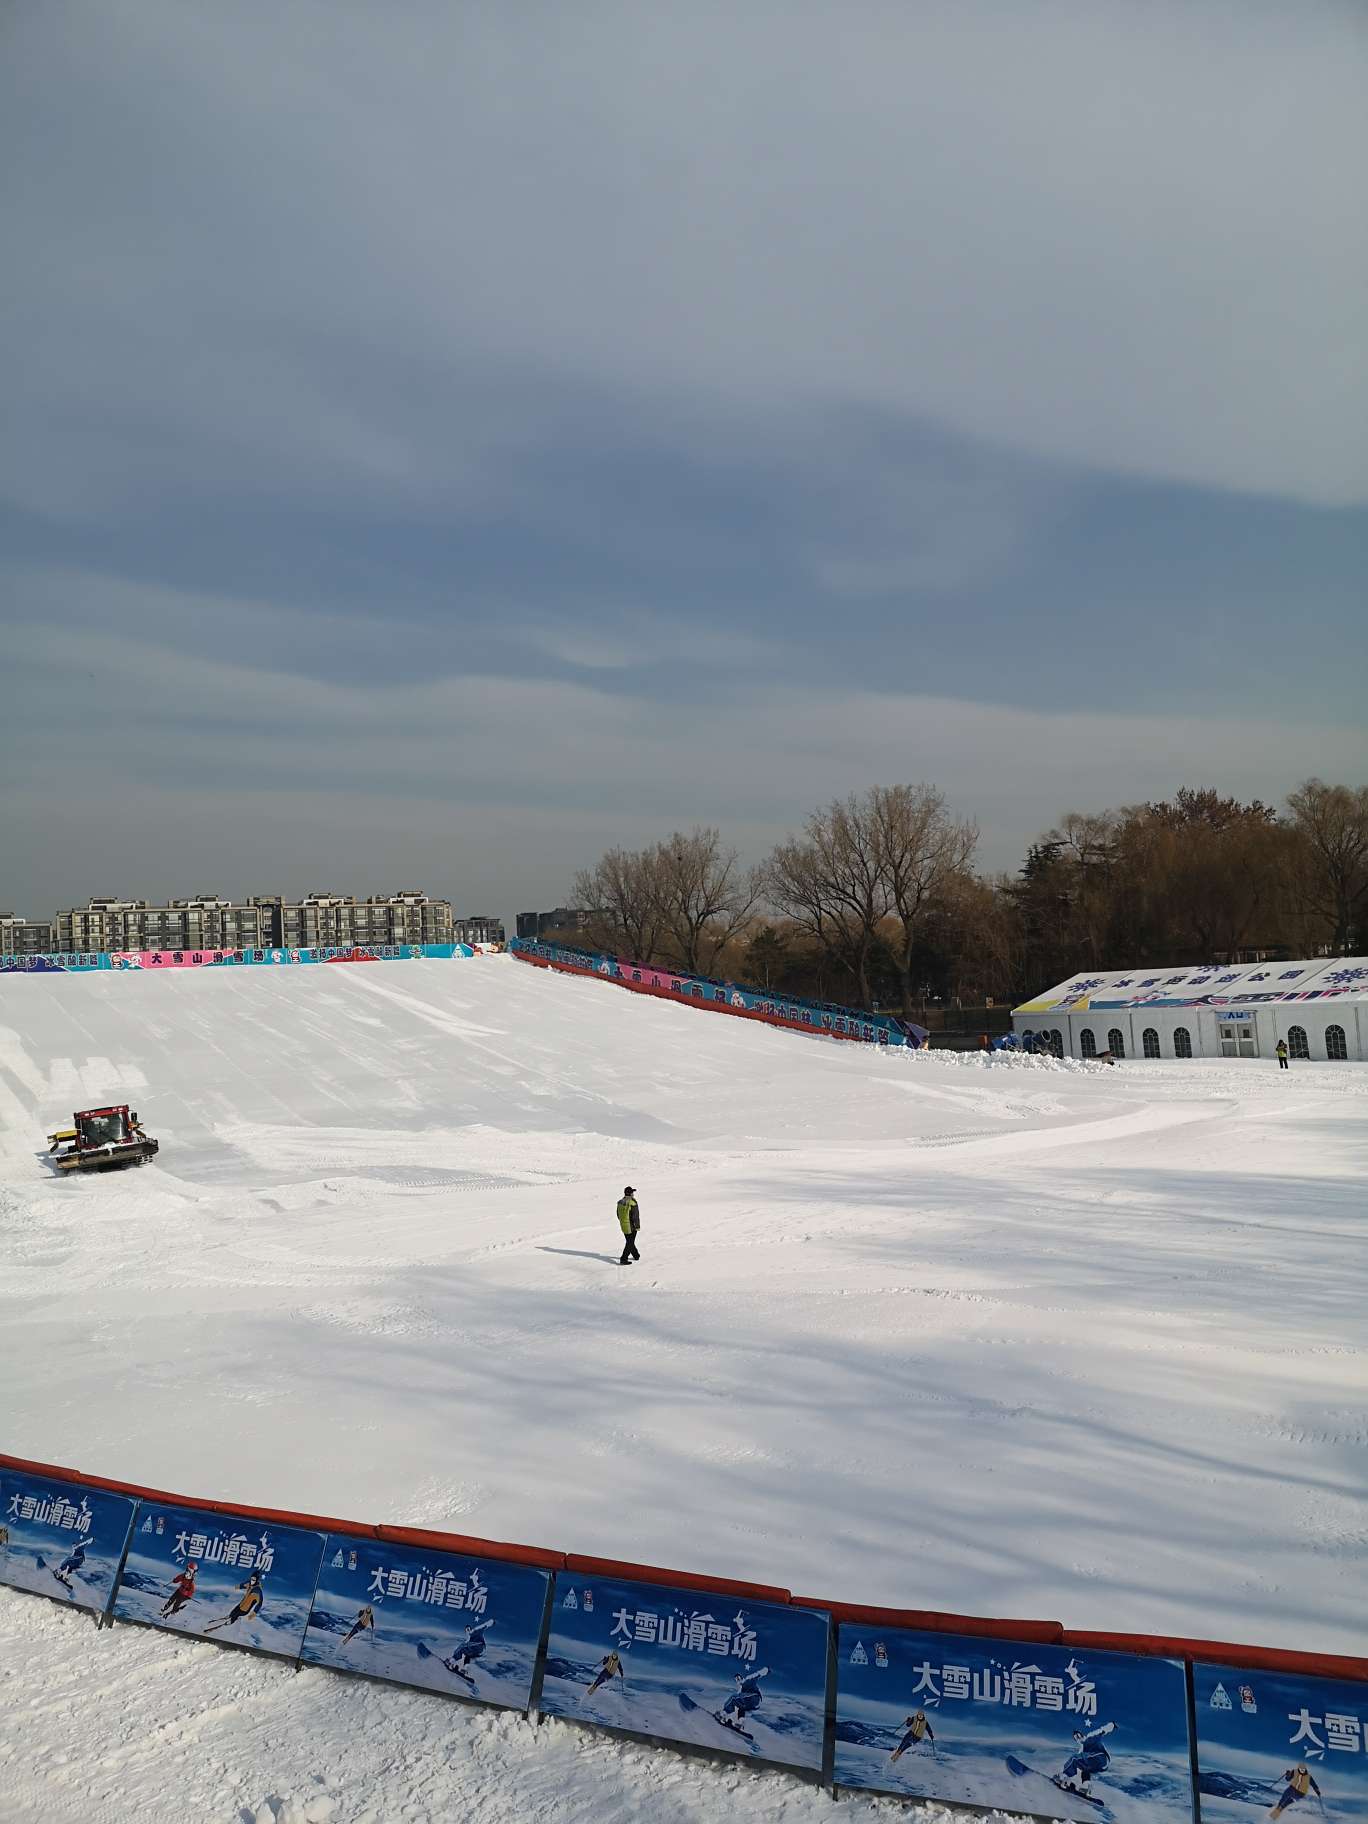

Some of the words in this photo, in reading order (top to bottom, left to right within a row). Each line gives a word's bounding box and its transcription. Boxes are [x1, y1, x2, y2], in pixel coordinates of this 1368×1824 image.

[0, 954, 38, 968] 中国梦
[152, 951, 264, 964] 大雪山滑雪场
[7, 1493, 93, 1533] 大雪山滑雪场
[172, 1530, 275, 1572] 大雪山滑雪场
[367, 1566, 489, 1613] 大雪山滑雪场
[610, 1607, 758, 1661] 大雪山滑雪场
[913, 1658, 1097, 1716] 大雪山滑雪场
[1288, 1708, 1368, 1752] 大雪
